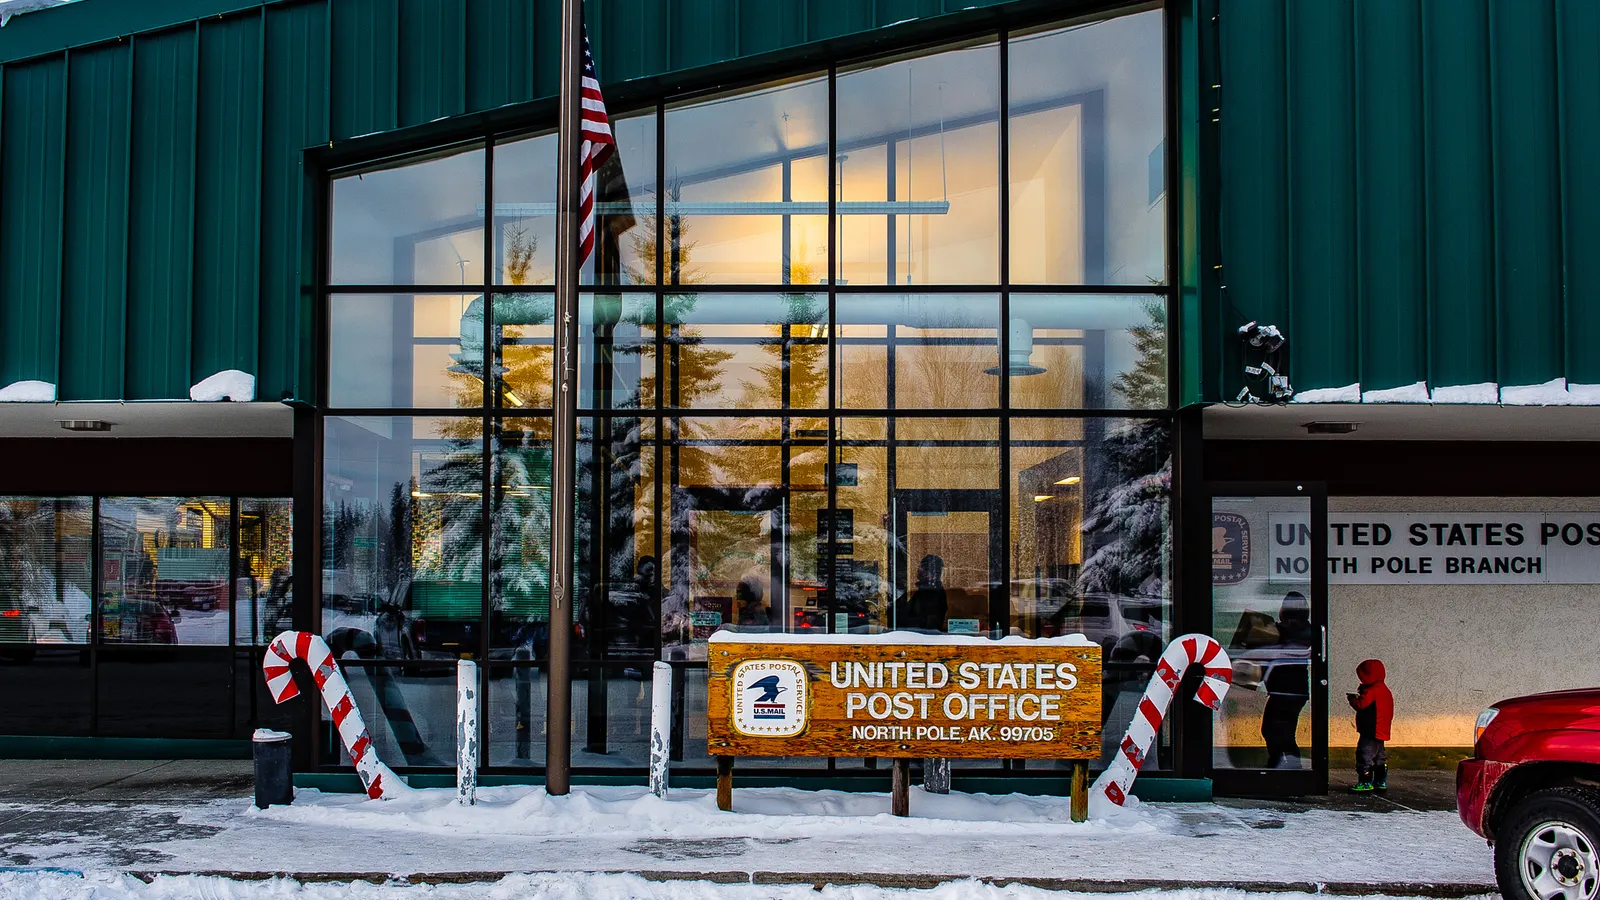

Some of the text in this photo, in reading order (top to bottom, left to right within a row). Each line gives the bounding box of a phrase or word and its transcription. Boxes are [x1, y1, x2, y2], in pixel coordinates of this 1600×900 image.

[1214, 515, 1246, 528] POSTAL
[1275, 523, 1391, 546] UNTED
[1409, 523, 1524, 546] STATES
[1276, 557, 1541, 574] NOTH POLE BRANCH
[830, 661, 1078, 690] UNITED STATES
[738, 663, 766, 679] STATES
[769, 663, 801, 677] POSTAL
[795, 678, 803, 715] SERVICE
[846, 692, 1061, 721] POST OFFICE
[852, 726, 1054, 743] NORTH POLE, AK. 99705
